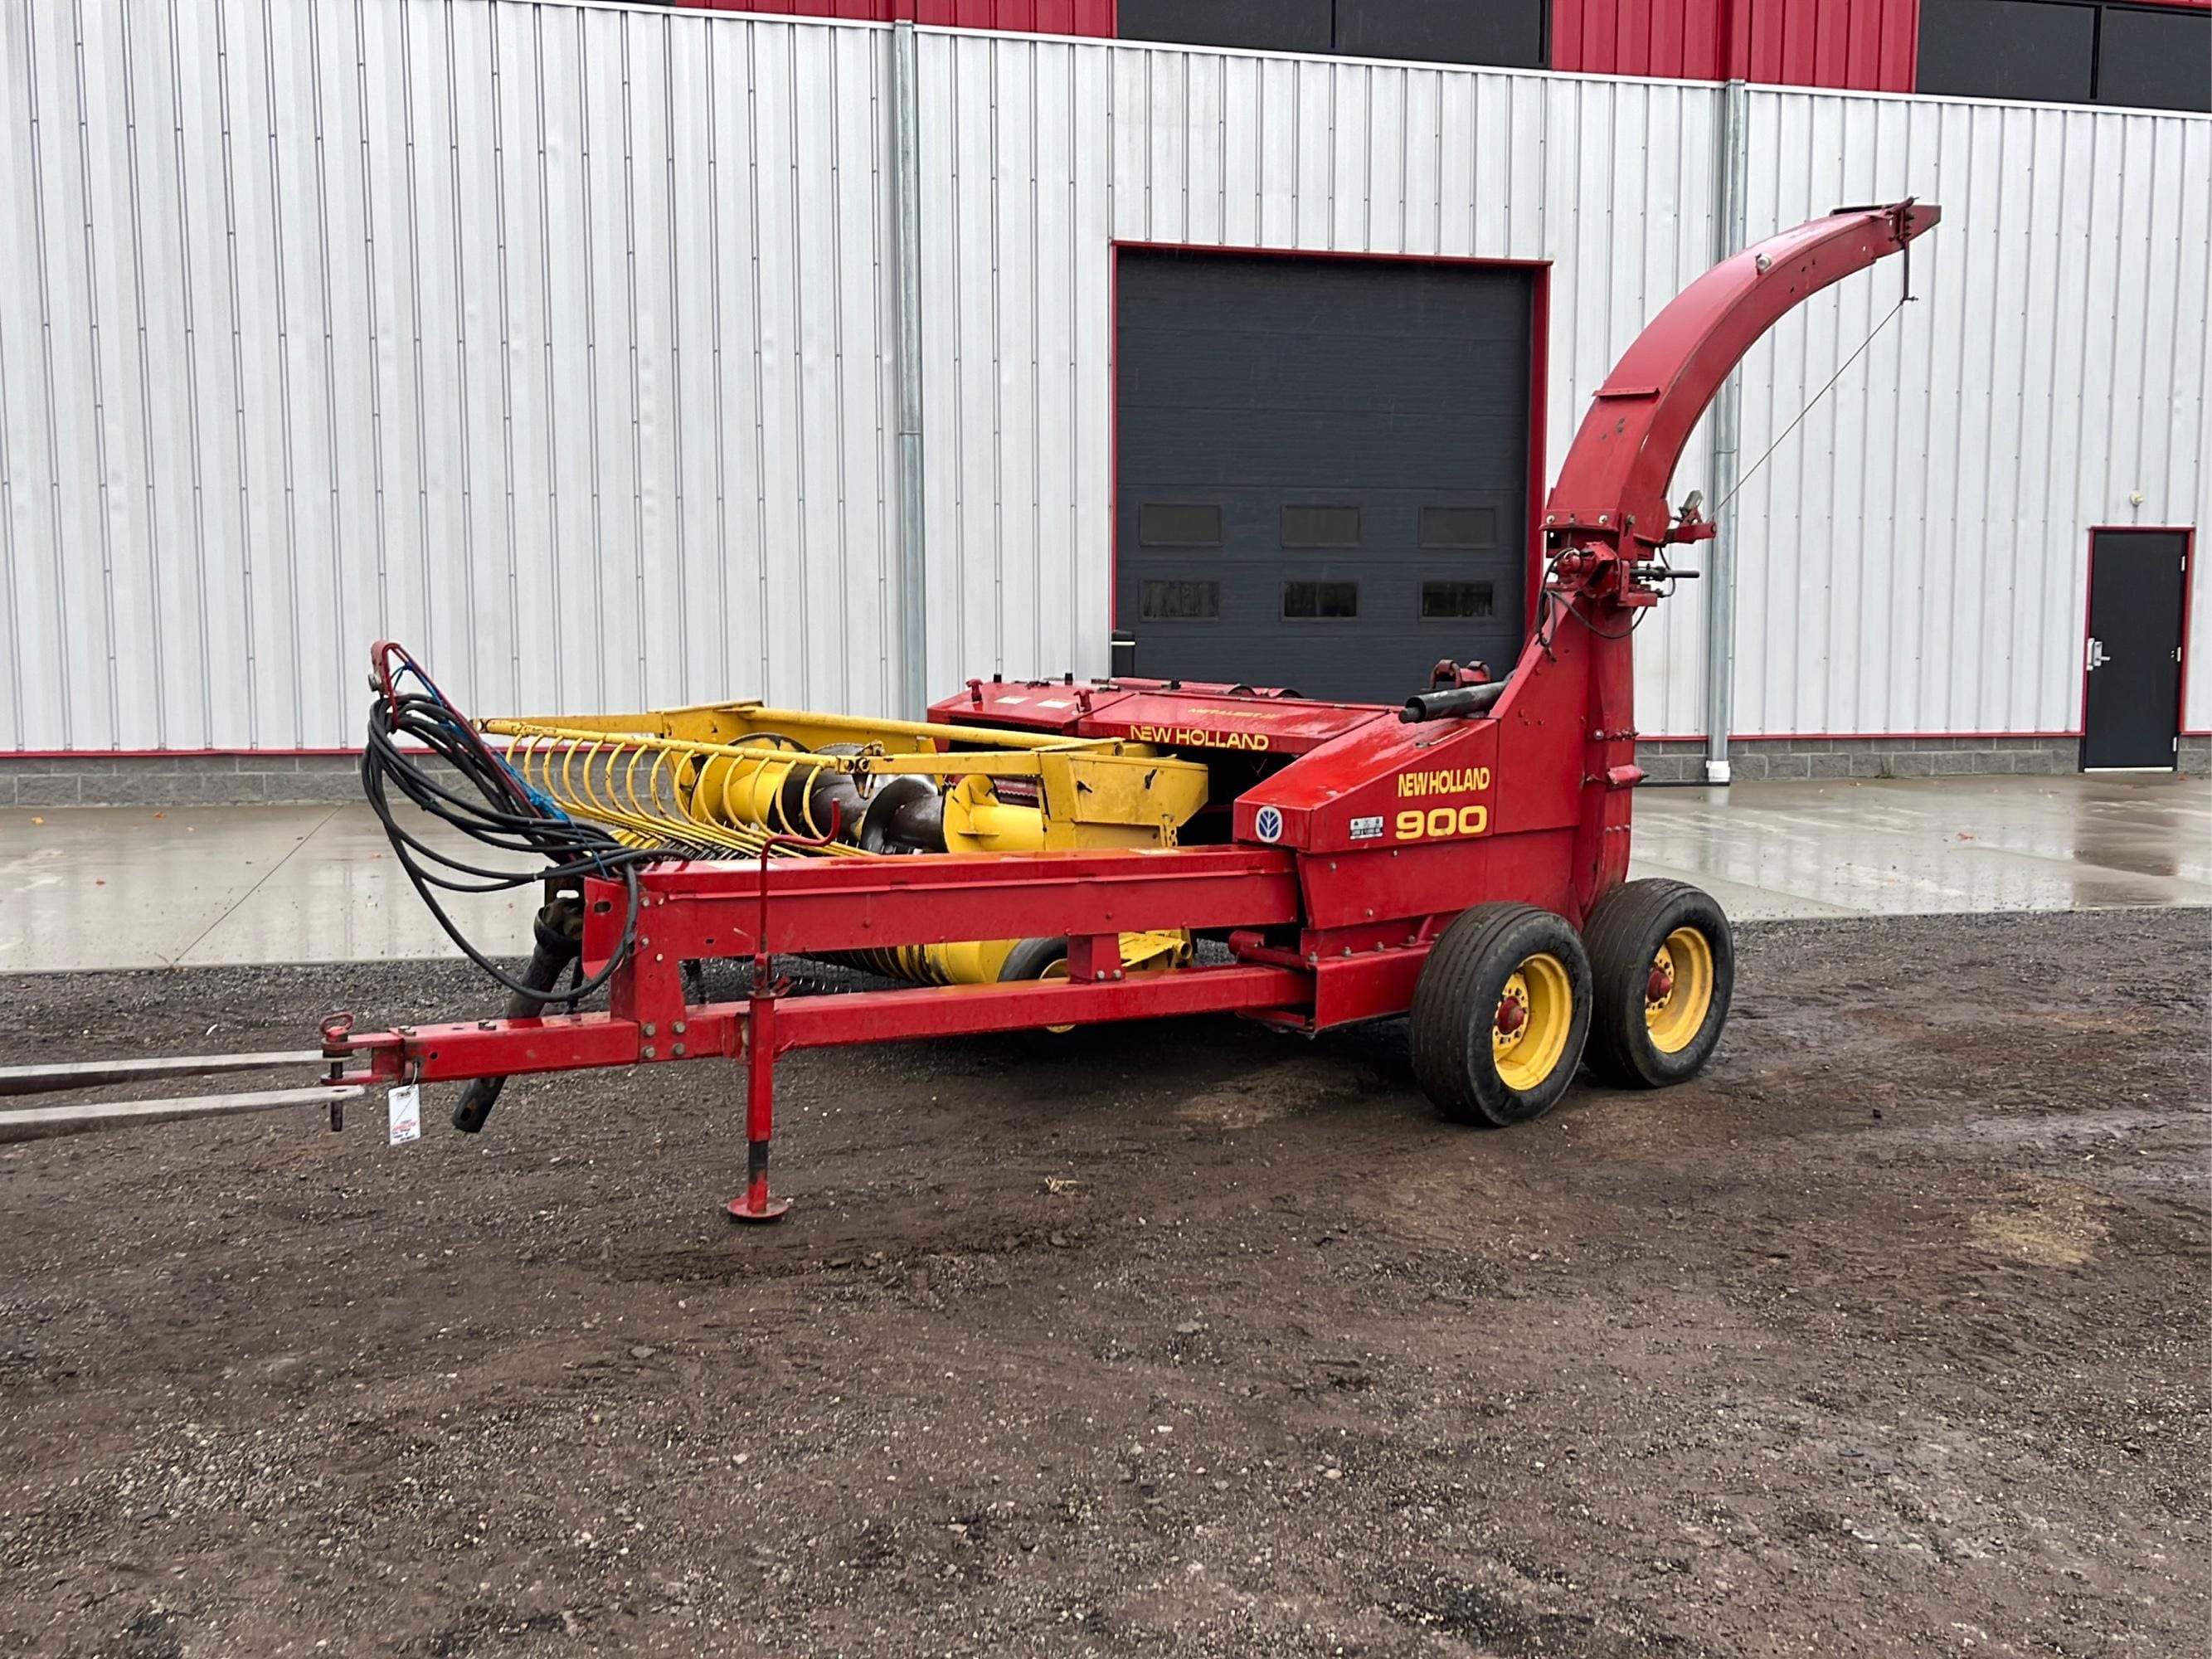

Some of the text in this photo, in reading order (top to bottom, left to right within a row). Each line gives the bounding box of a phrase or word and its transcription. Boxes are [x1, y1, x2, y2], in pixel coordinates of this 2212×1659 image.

[1130, 724, 1270, 752] NEW HOLLAND
[1398, 766, 1490, 797] NEW HOLLAND
[1395, 805, 1488, 839] 900
